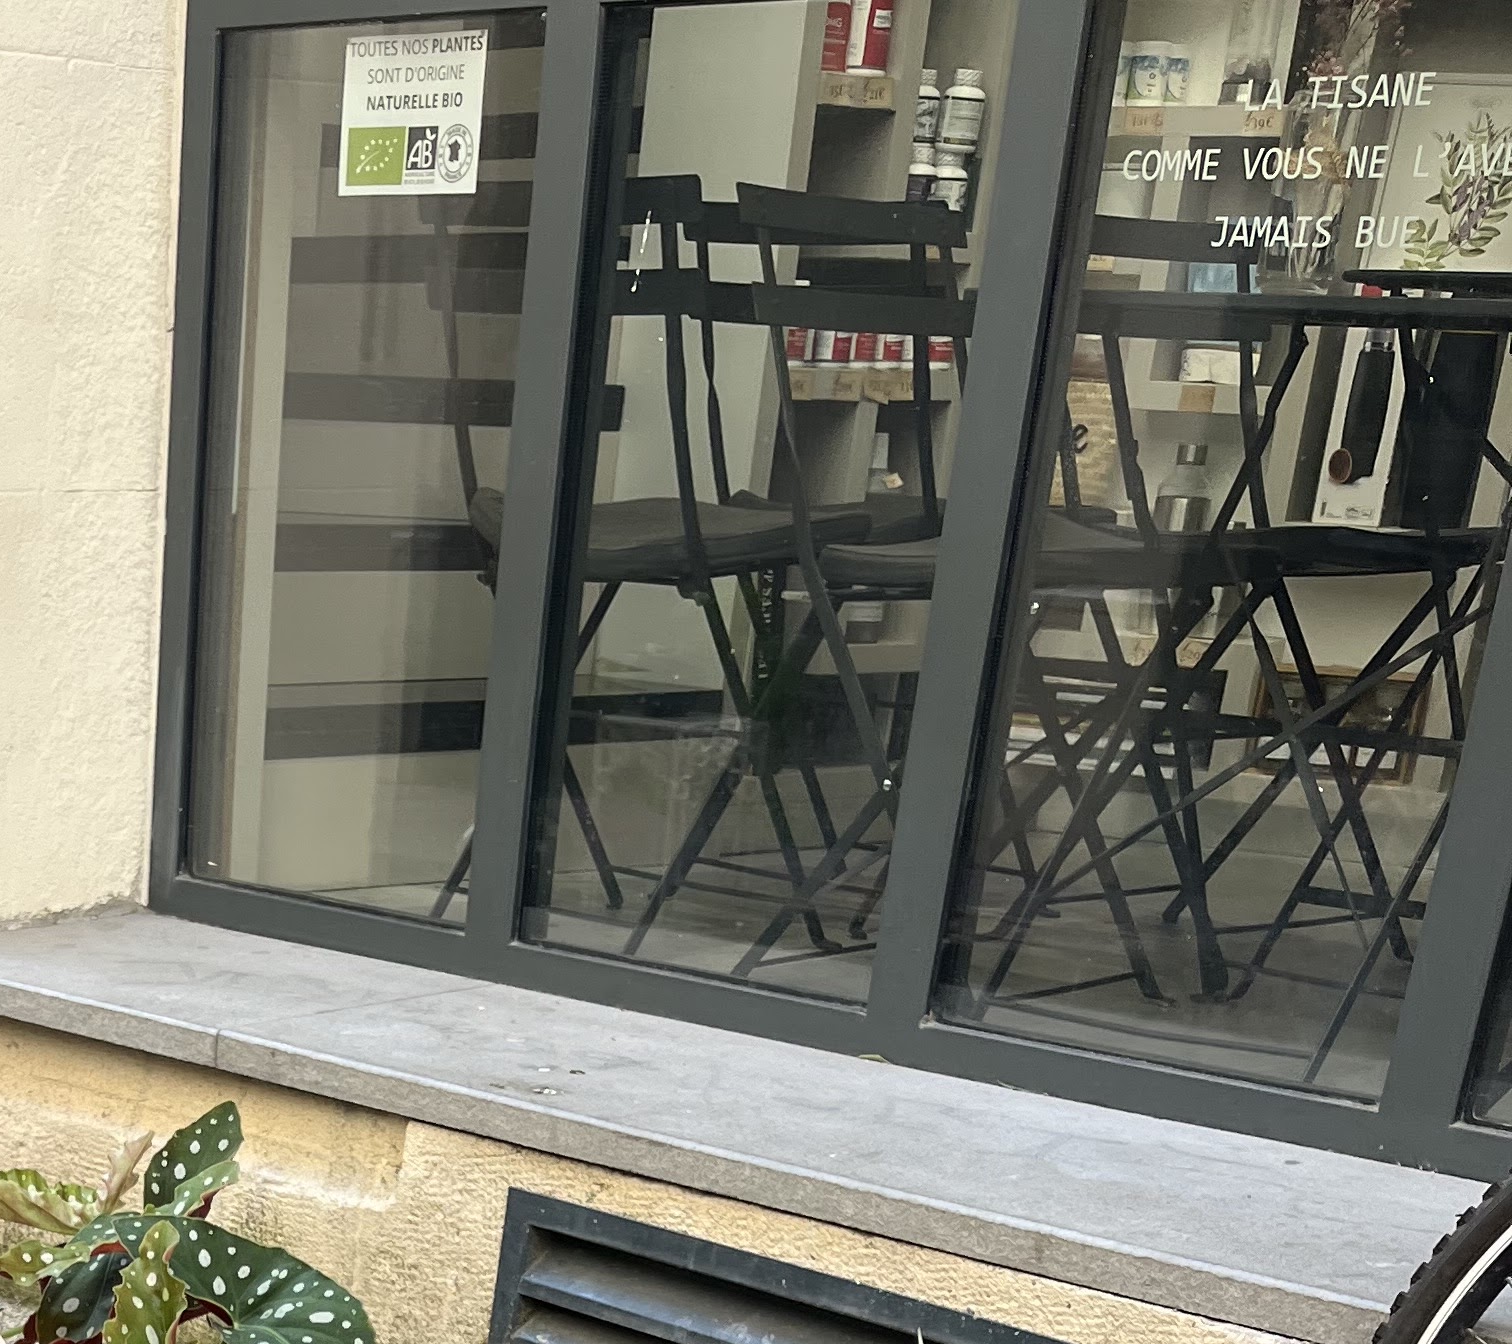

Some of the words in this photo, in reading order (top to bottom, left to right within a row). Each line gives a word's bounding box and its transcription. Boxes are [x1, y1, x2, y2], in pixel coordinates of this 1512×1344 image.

[350, 40, 398, 58] TOUTES
[401, 38, 429, 56] NOS
[431, 35, 484, 53] PLANTES
[367, 67, 403, 84] SONT
[404, 63, 465, 83] D'ORIGINE
[366, 93, 439, 111] NATURELLE
[441, 92, 464, 108] BIO
[1243, 78, 1283, 112] LA
[1307, 71, 1437, 110] TISANE
[406, 139, 433, 169] AB
[1121, 147, 1222, 182] COMME
[1242, 145, 1325, 181] VOUS
[1345, 144, 1390, 180] NE
[1210, 215, 1334, 249] JAMAIS
[1354, 215, 1421, 249] BUE
